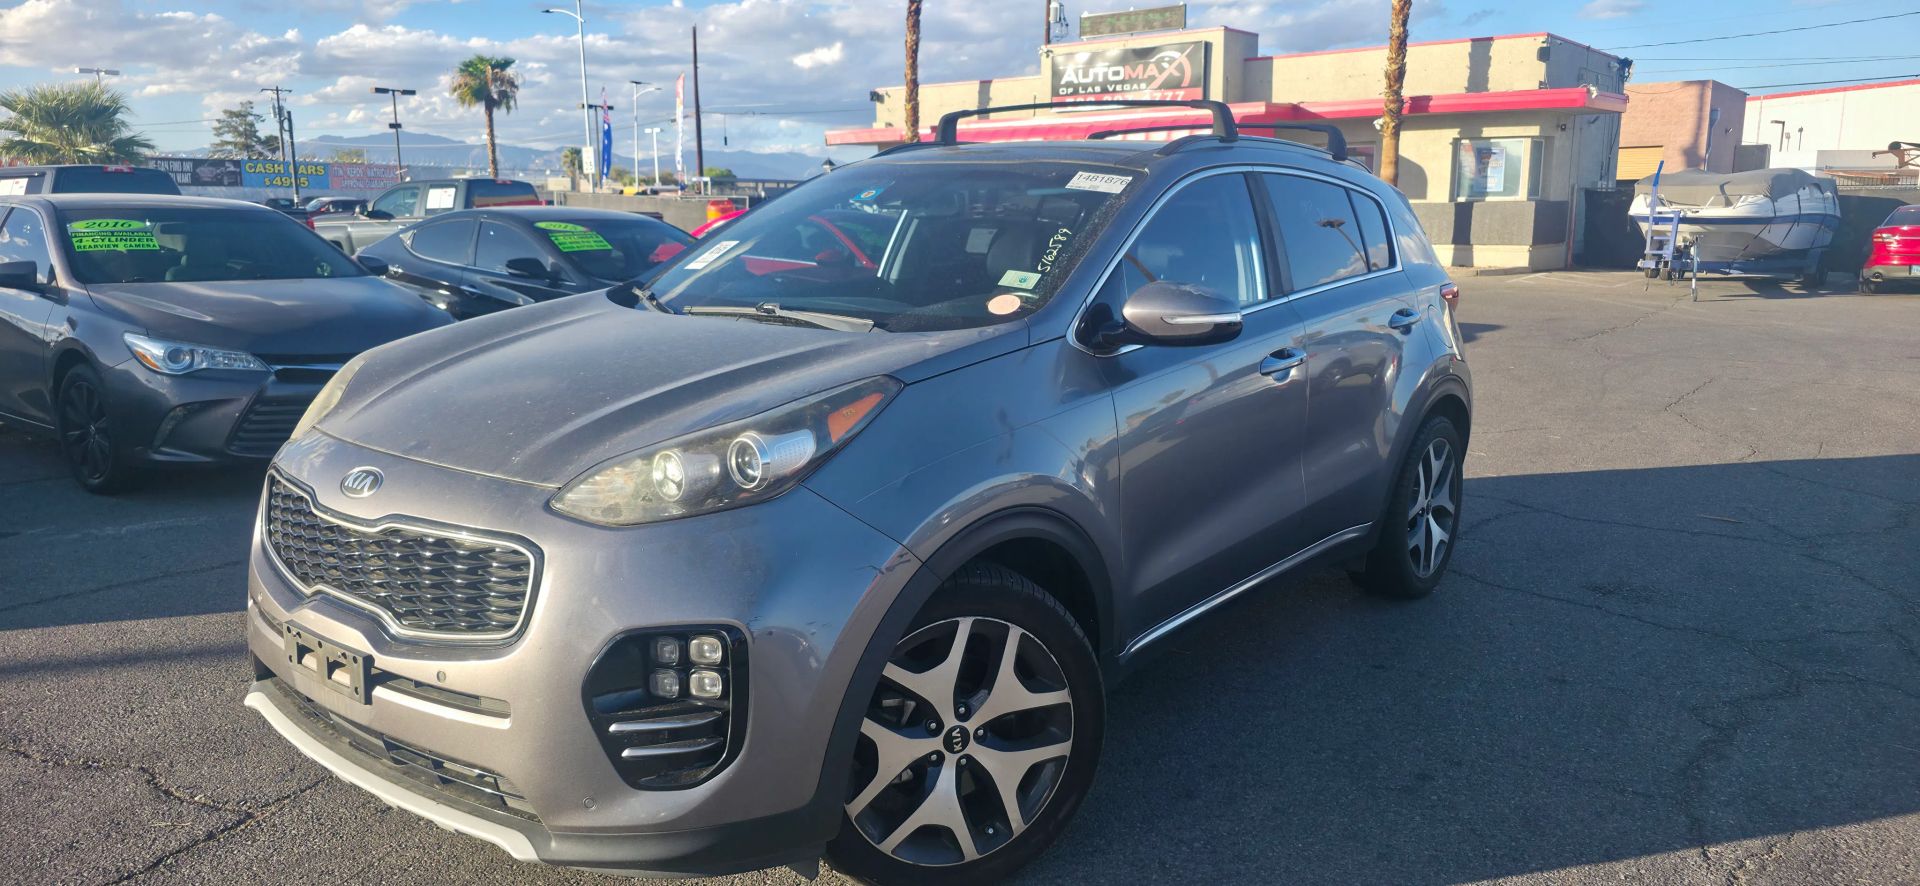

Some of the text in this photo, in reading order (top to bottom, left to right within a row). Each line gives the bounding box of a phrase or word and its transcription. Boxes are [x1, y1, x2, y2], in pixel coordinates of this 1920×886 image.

[1060, 58, 1184, 88] AUTOMAX
[1059, 87, 1074, 95] OF
[1107, 83, 1147, 92] VEGAS
[169, 160, 182, 172] FIND
[183, 160, 193, 172] ANY
[245, 163, 284, 174] CASH
[1077, 173, 1130, 186] 1481876
[84, 221, 132, 229] 2016
[1037, 228, 1072, 273] 5162589
[344, 471, 374, 494] KIA
[952, 728, 962, 752] KIA
